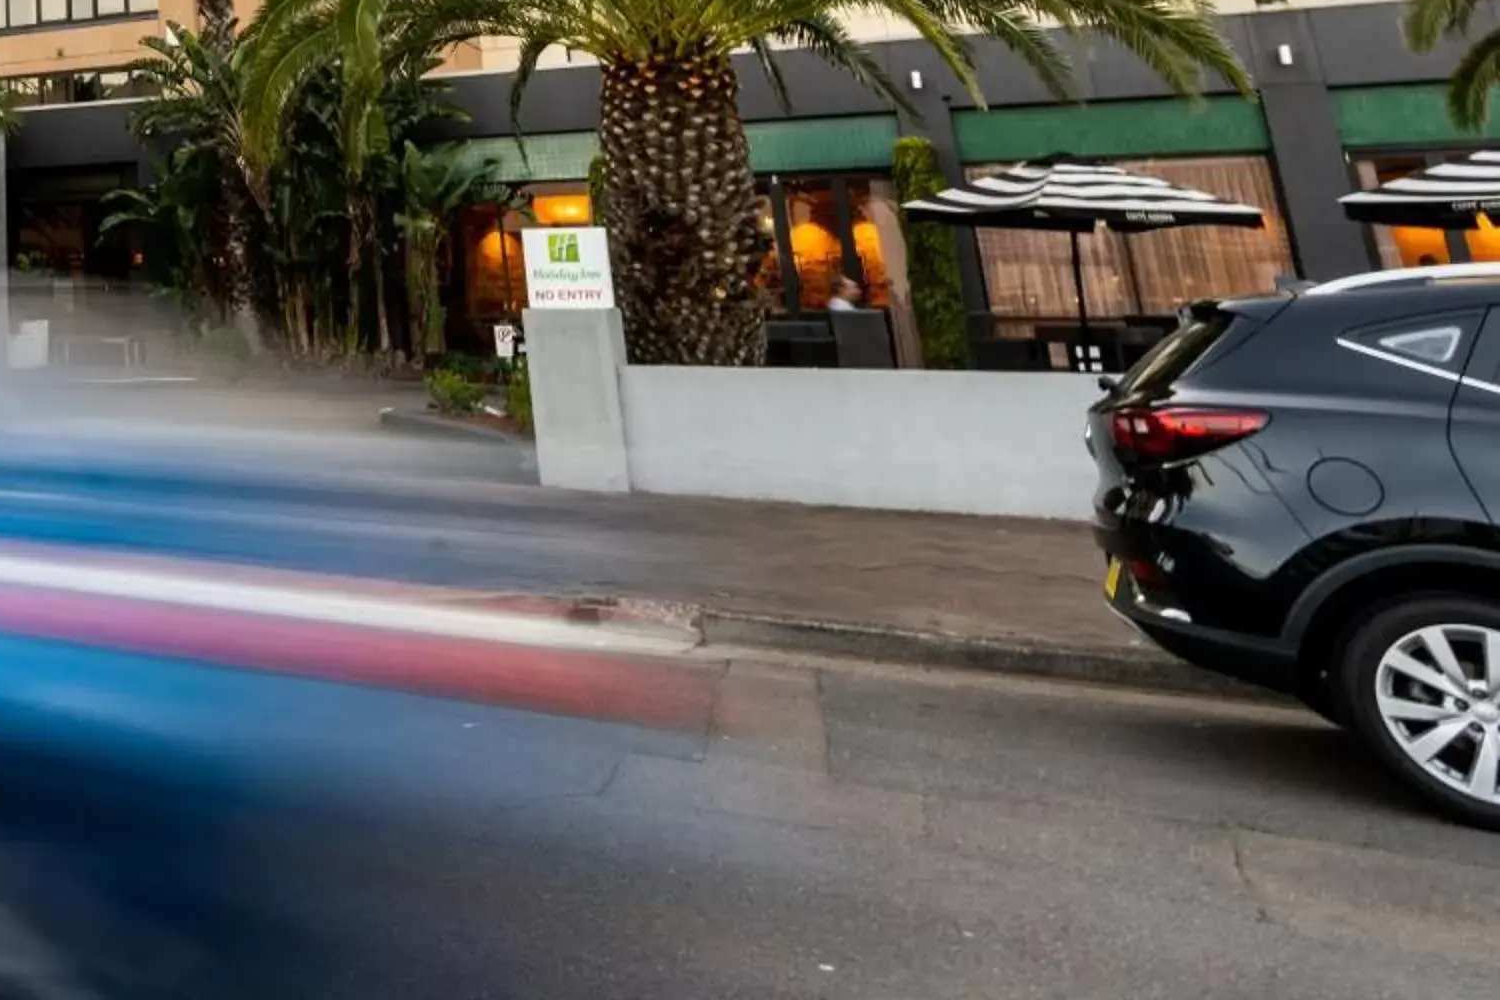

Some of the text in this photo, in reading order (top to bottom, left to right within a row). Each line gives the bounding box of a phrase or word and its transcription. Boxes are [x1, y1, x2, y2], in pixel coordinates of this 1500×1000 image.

[533, 268, 602, 281] Holiday Inn
[535, 289, 603, 300] NO ENTRY
